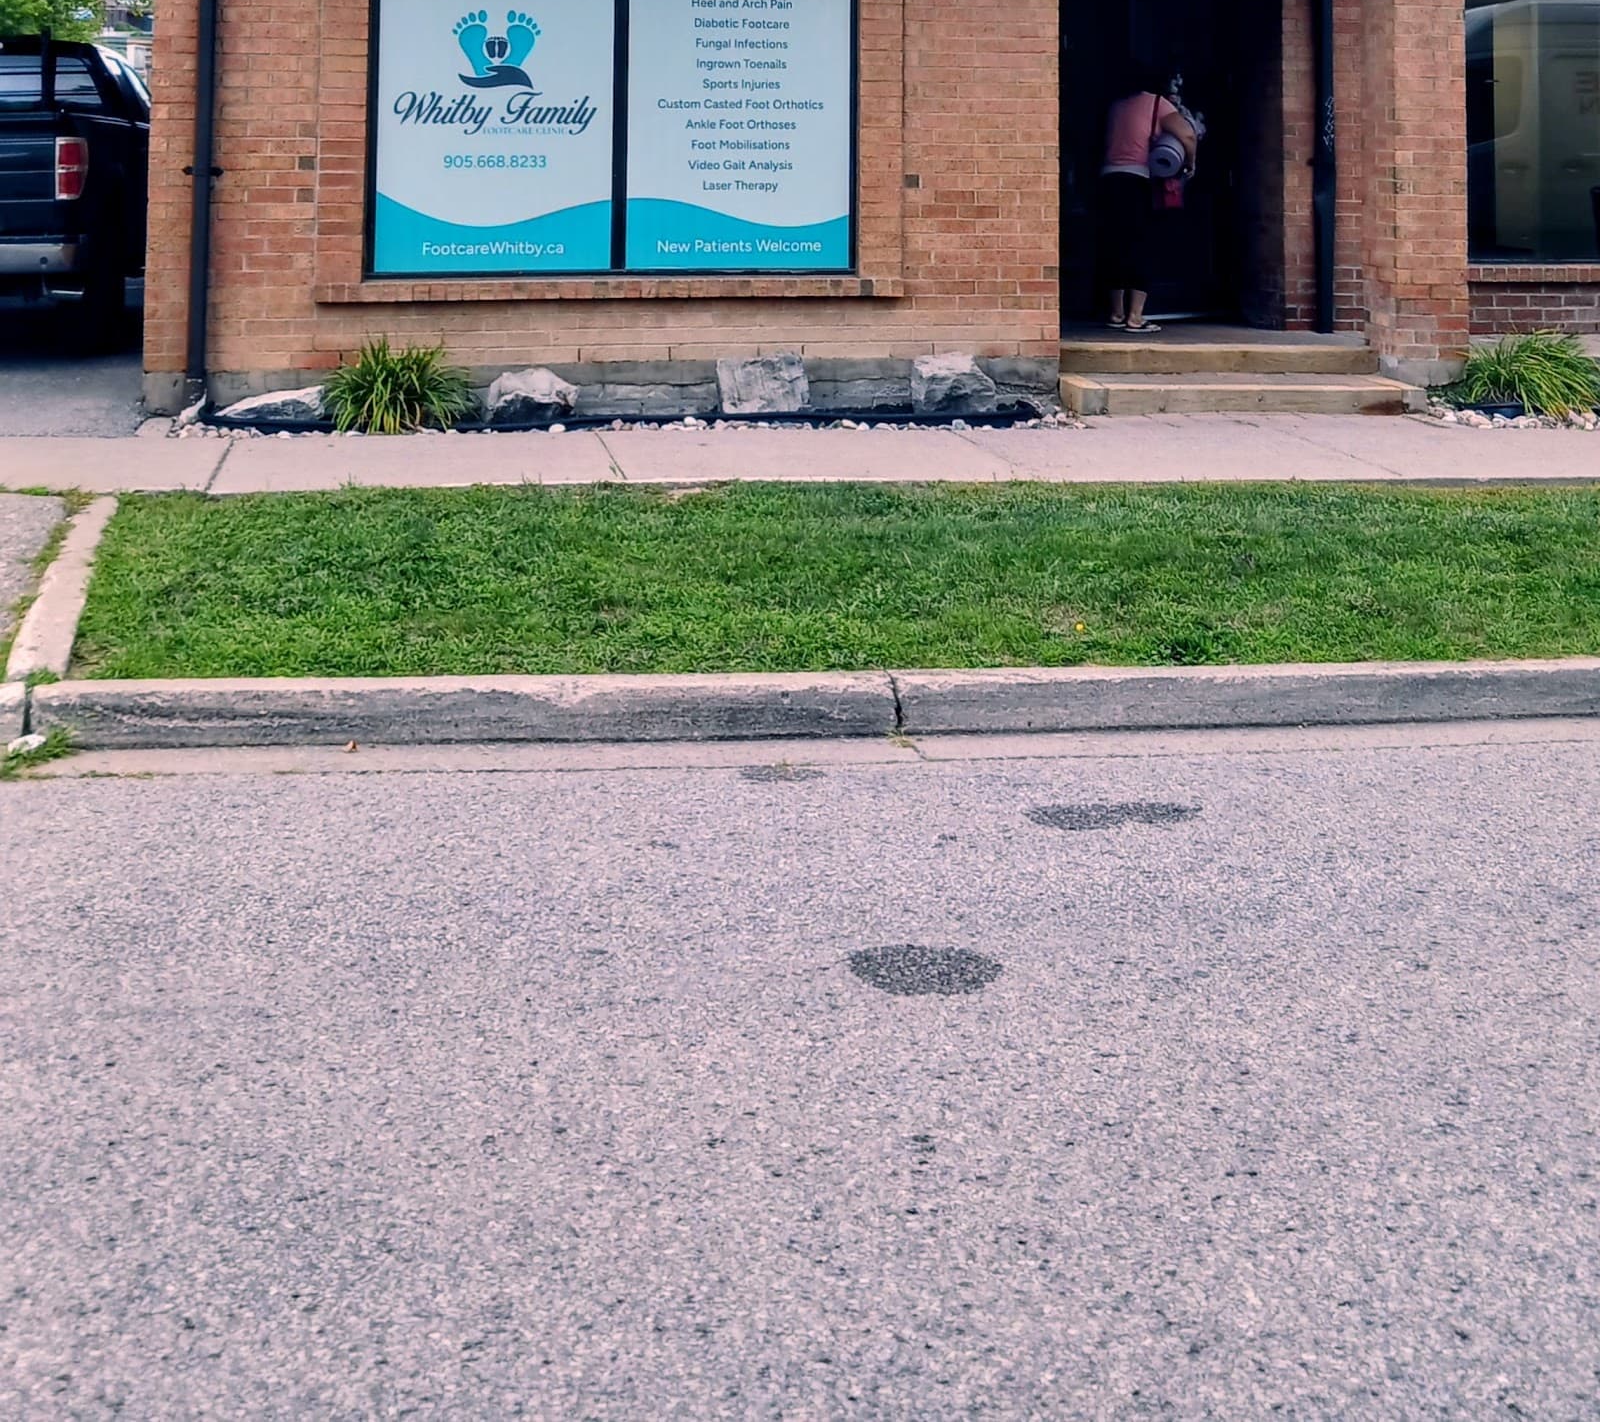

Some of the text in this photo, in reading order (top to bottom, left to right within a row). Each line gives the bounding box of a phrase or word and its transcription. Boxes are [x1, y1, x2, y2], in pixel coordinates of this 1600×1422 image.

[694, 17, 790, 30] Diabetic Footcare
[695, 37, 789, 50] Fungal Infections
[696, 58, 788, 71] Ingrown Toenails
[702, 78, 781, 91] Sports Injuries
[657, 98, 824, 110] Custom Casted Foot Orthotics
[392, 90, 598, 135] Whitby Family
[684, 118, 797, 130] Ankle Foot Orthoses
[691, 139, 791, 151] Foot Mobilisations
[443, 154, 547, 168] 905.668.8233
[687, 159, 793, 172] Video Gait Analysis
[702, 179, 779, 192] Laser Therapy
[421, 241, 564, 257] FootcareWhitby.ca
[657, 238, 822, 253] New Patients Welcome
